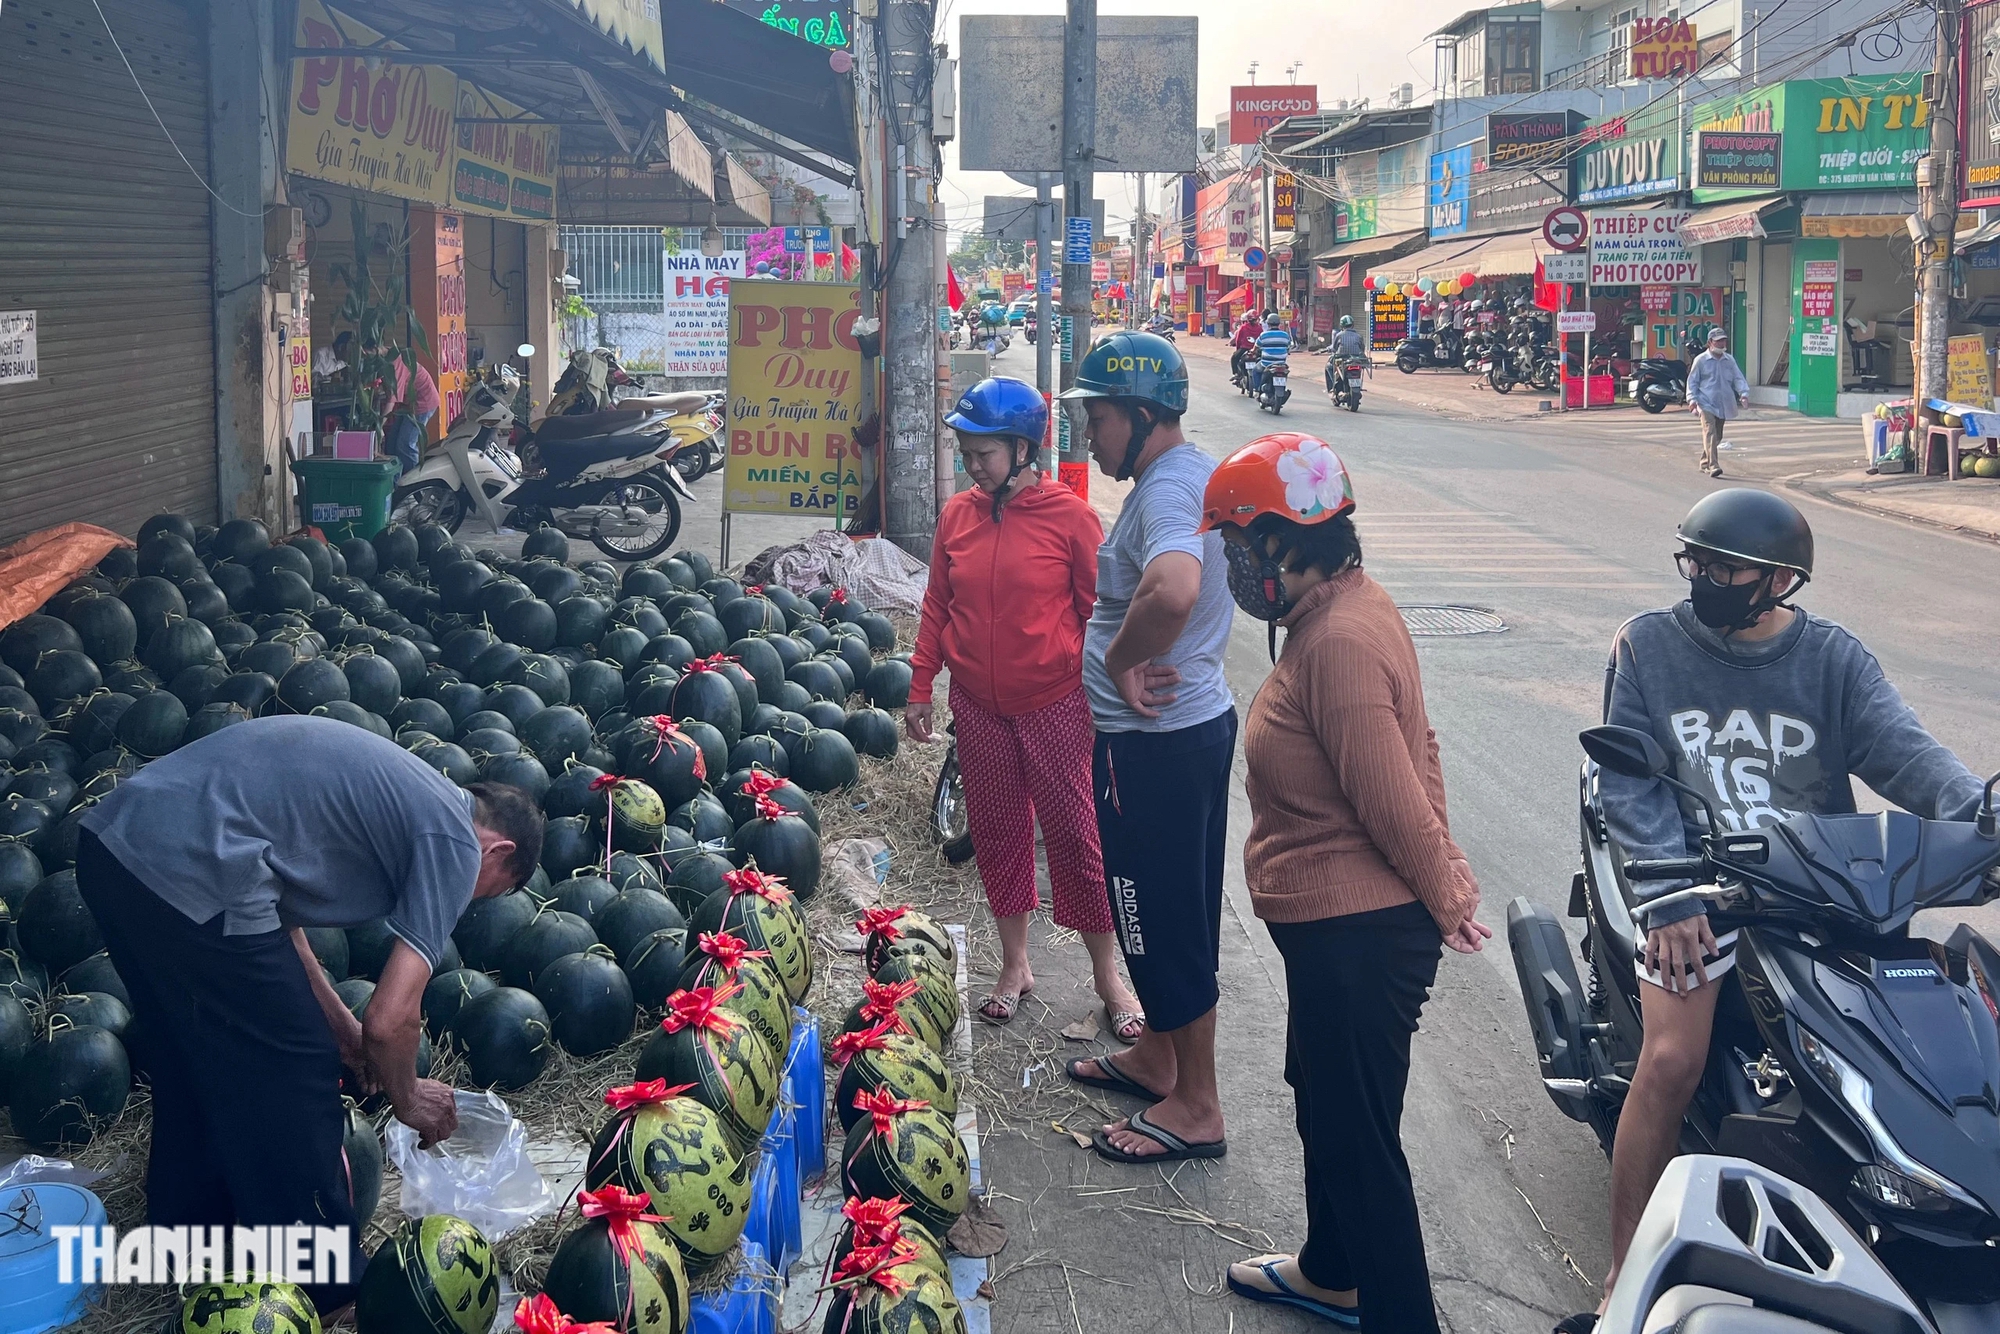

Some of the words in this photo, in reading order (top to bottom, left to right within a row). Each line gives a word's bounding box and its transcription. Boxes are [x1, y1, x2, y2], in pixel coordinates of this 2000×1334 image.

[804, 11, 847, 45] GÀ
[1635, 17, 1693, 44] HOA
[1236, 99, 1312, 112] KINGFOOD
[1816, 97, 1872, 133] IN
[1521, 118, 1563, 137] THÀNH
[1703, 136, 1778, 151] PHOTOCOPY
[1706, 153, 1742, 169] THIỆP
[1819, 150, 1857, 170] THIỆP
[1859, 145, 1893, 167] CƯỚI
[1722, 171, 1750, 184] PHÒNG
[1231, 209, 1246, 226] PET
[1594, 213, 1648, 238] THIỆP
[1229, 232, 1248, 248] SHOP
[1594, 238, 1621, 249] MÂM
[1623, 237, 1645, 249] QUẢ
[1648, 239, 1676, 251] TRỌN
[668, 254, 700, 270] NHÀ
[705, 257, 740, 270] MAY
[1597, 252, 1629, 262] TRANG
[1632, 250, 1649, 262] TRÍ
[1651, 252, 1667, 261] GIA
[1592, 264, 1698, 283] PHOTOCOPY
[1805, 301, 1815, 309] XE
[1816, 300, 1831, 309] MÁY
[675, 320, 686, 328] ÁO
[689, 320, 703, 328] DÀI
[674, 349, 697, 358] NHẬN
[699, 350, 715, 358] DẠY
[667, 361, 690, 373] NHẬN
[1106, 356, 1162, 374] DQTV
[293, 369, 310, 396] GÀ
[763, 352, 853, 398] Duy
[732, 396, 760, 420] Gia
[766, 397, 818, 424] Truyền
[824, 399, 848, 422] Hà
[730, 423, 810, 459] BÚN
[747, 464, 811, 484] MIẾN
[819, 468, 860, 486] GÀ
[789, 485, 839, 509] BẮP
[1670, 709, 1817, 765] BAD
[1705, 754, 1772, 804] IS
[1120, 876, 1141, 932] ADIDAS
[1883, 968, 1937, 978] HONDA
